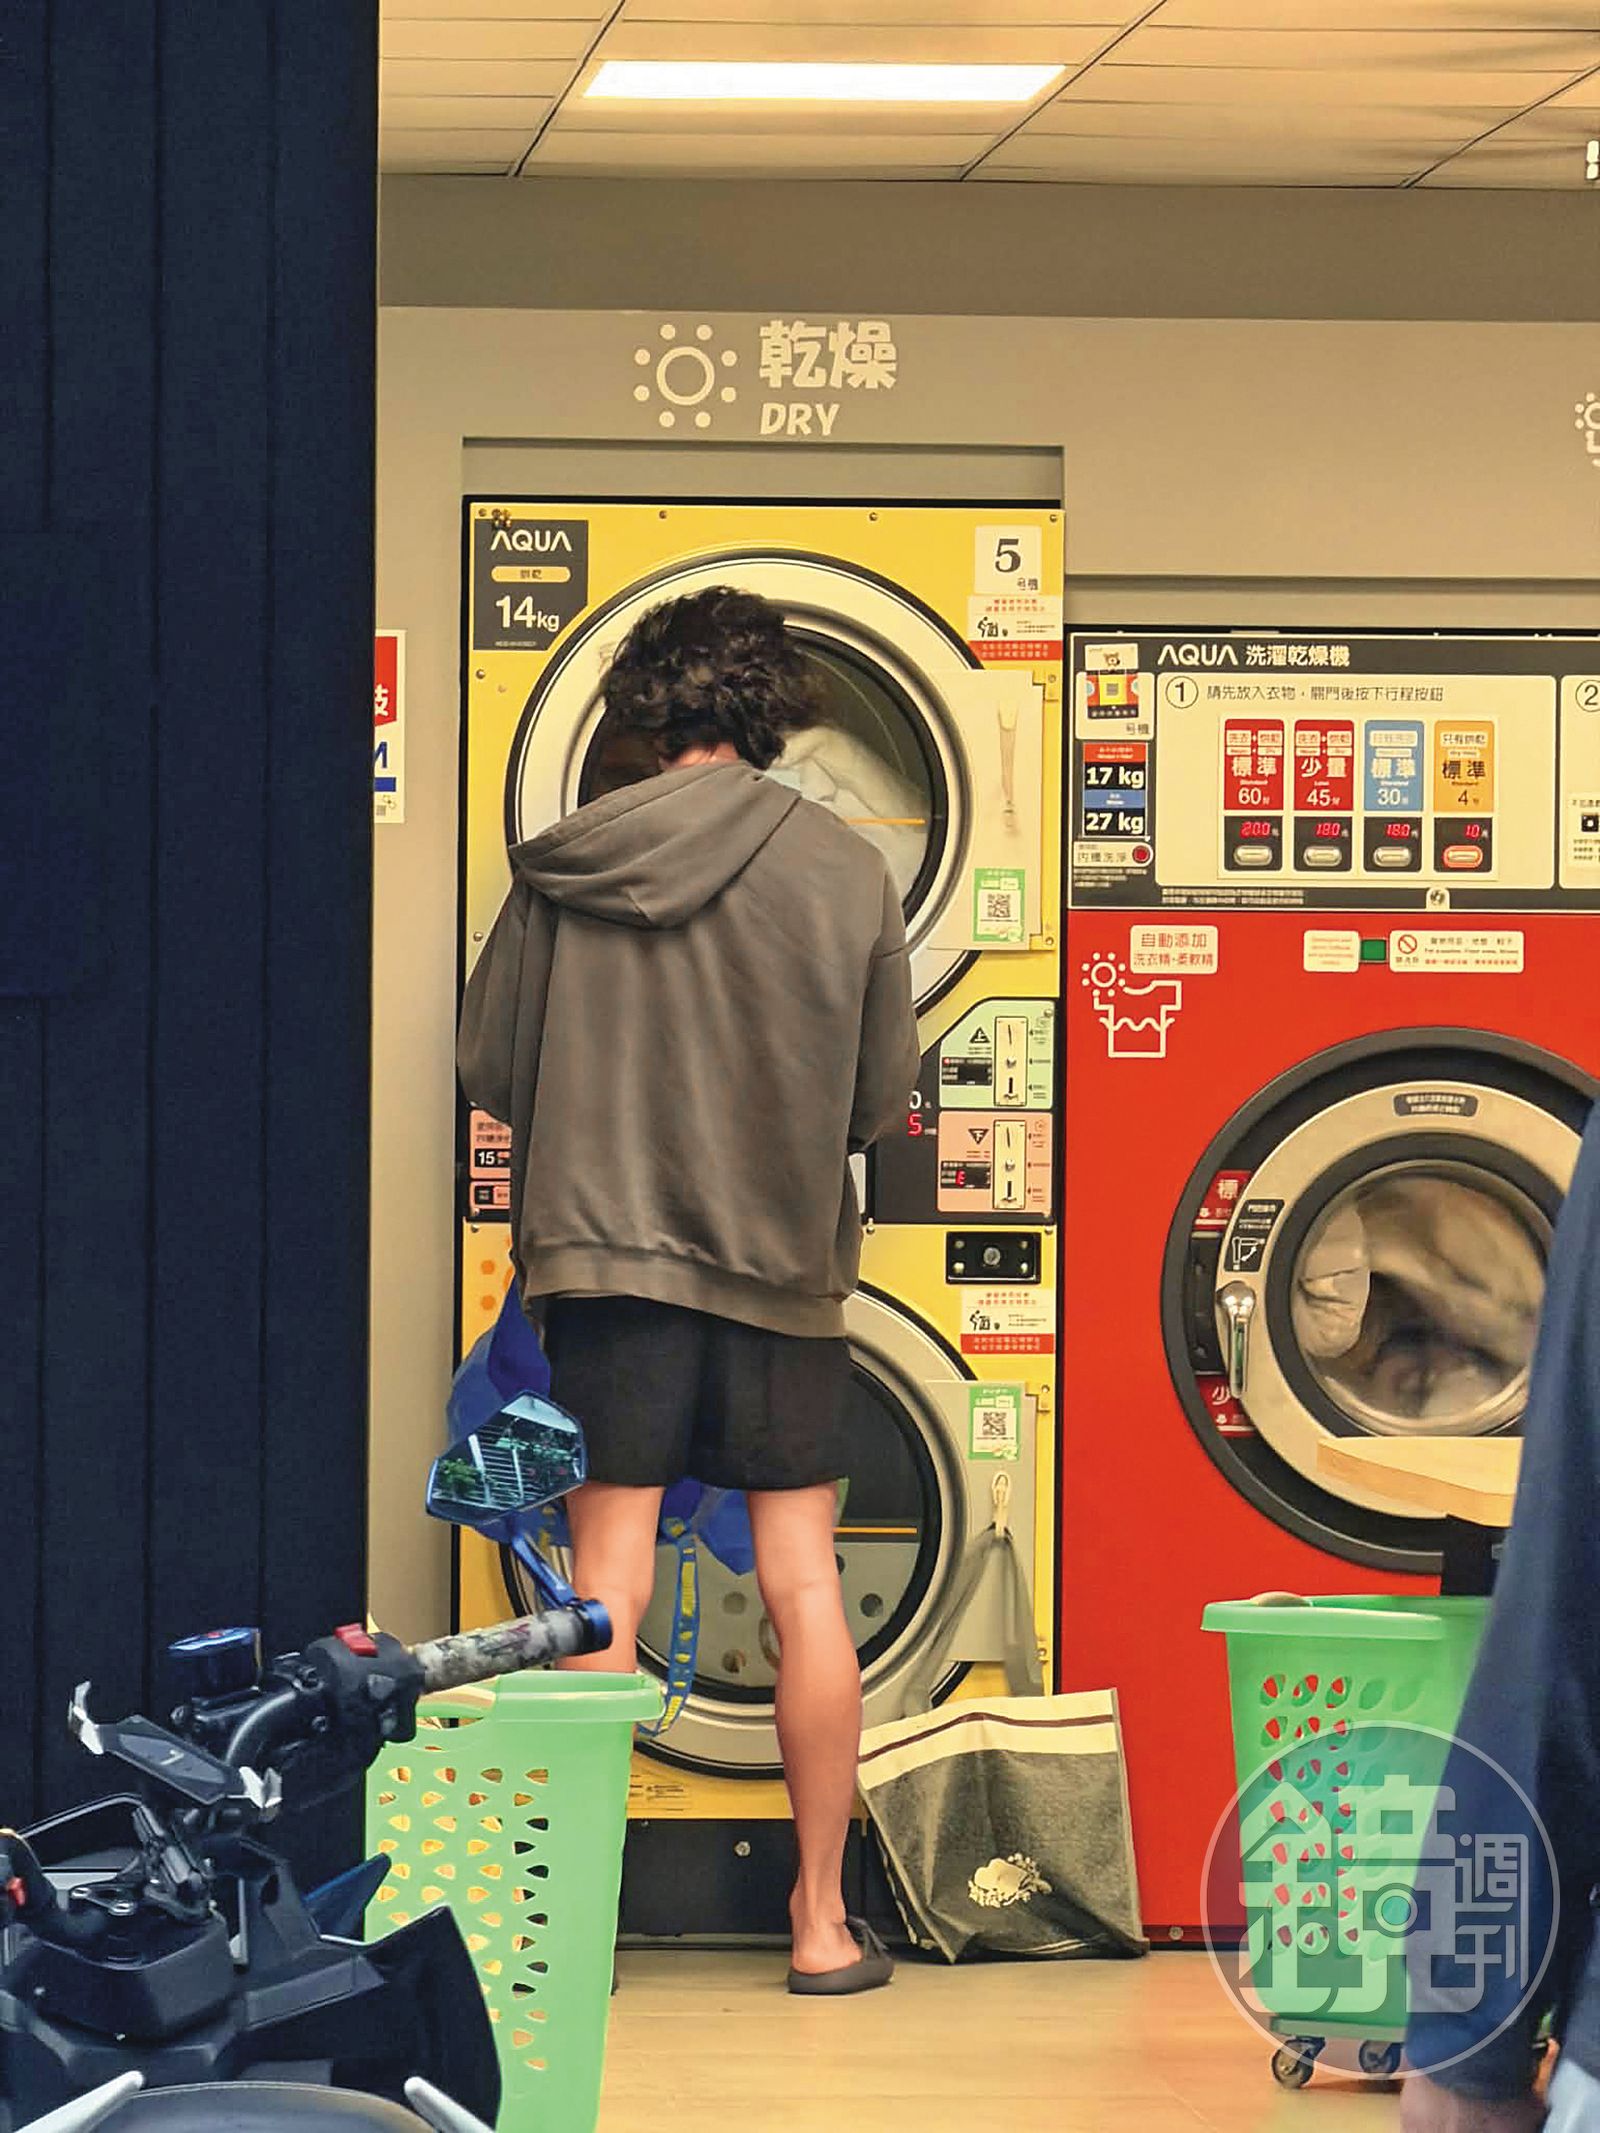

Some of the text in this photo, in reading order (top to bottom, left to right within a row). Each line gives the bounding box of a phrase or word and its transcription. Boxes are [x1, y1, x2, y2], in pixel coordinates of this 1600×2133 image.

[759, 320, 897, 389] 乾燥
[759, 402, 840, 436] DRY
[490, 529, 572, 552] AQUA
[995, 538, 1021, 572] 5
[495, 594, 560, 633] 14kg
[1157, 643, 1351, 668] AQUA 洗濯乾燥機
[1087, 765, 1144, 789] 17 kg
[1232, 756, 1277, 777] 標準
[1301, 757, 1347, 778] 少量
[1442, 760, 1486, 779] 標準
[1086, 812, 1144, 834] 27 kg
[1141, 933, 1208, 948] 自動添加
